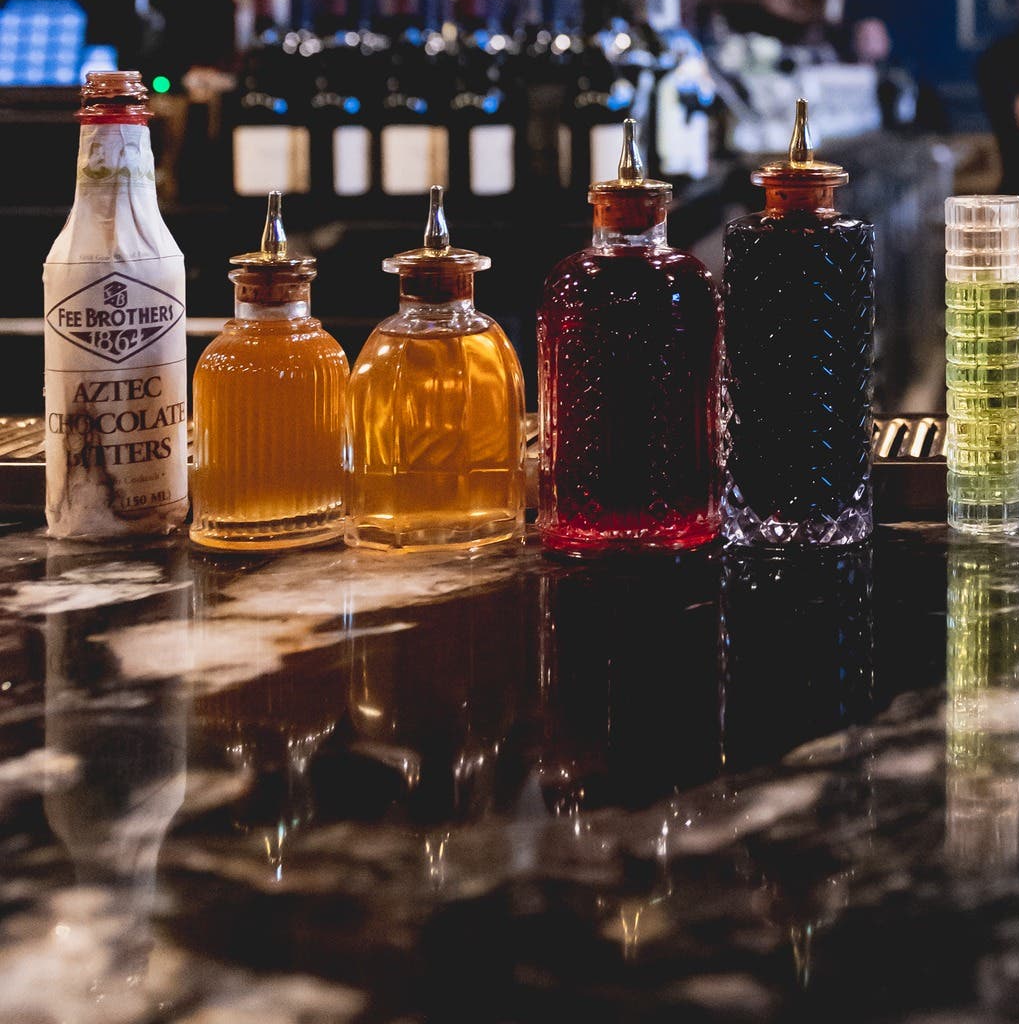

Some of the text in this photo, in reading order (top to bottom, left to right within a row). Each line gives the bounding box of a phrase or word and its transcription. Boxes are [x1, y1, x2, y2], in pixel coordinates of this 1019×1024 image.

[58, 305, 173, 327] FEE BROTHERS
[88, 329, 143, 354] 1864
[73, 376, 162, 403] AZTEC
[48, 402, 185, 434] CHOCOLATE
